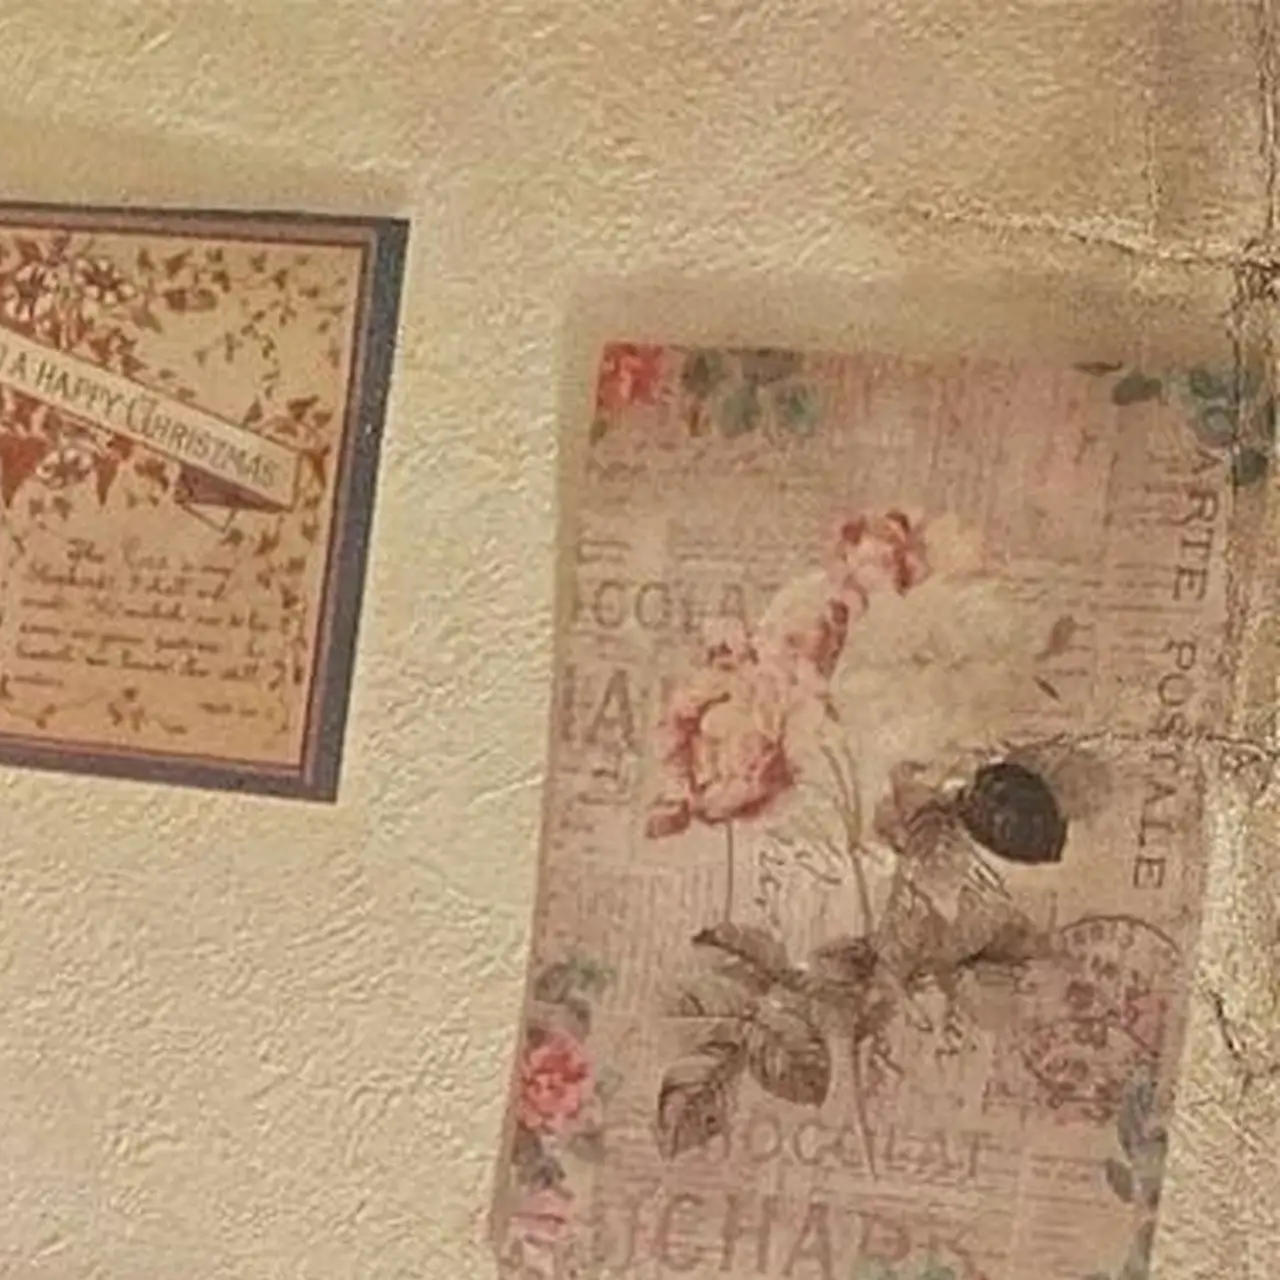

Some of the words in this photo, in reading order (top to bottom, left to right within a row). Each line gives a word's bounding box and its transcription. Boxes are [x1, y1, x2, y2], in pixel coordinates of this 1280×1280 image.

[10, 357, 28, 382] A
[35, 362, 122, 412] HAPPY
[126, 394, 277, 488] CHRISTMAS
[1175, 448, 1222, 600] ARTE
[1133, 636, 1196, 890] POSTALE
